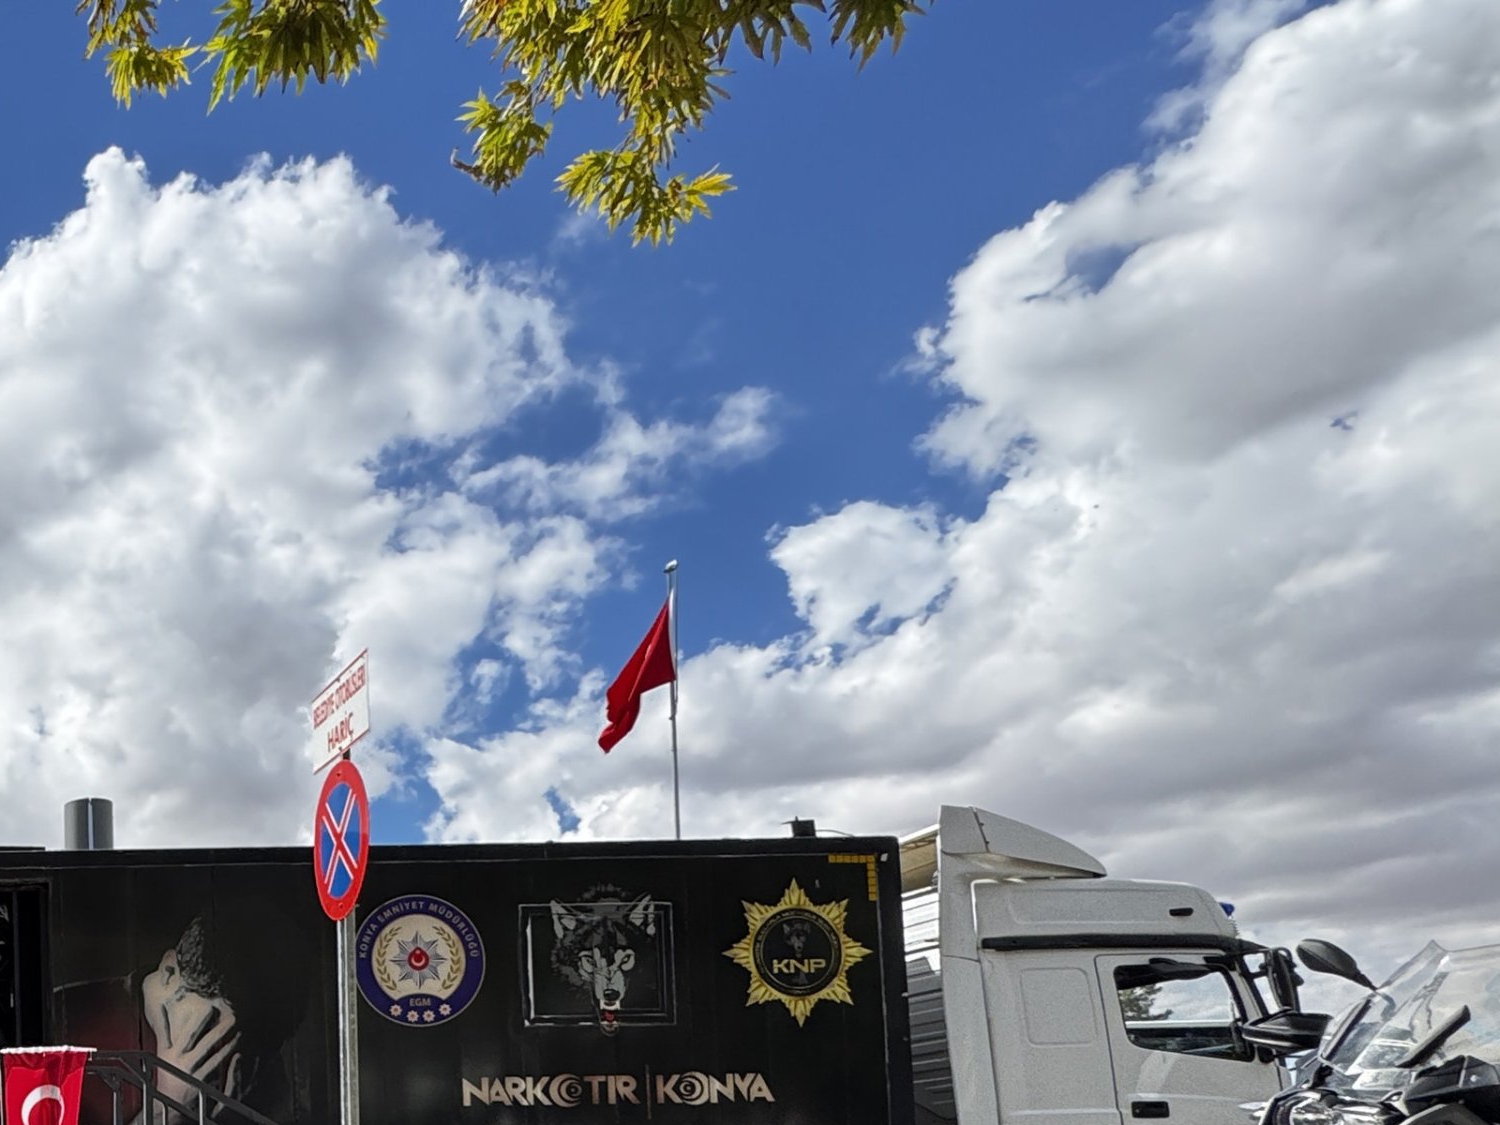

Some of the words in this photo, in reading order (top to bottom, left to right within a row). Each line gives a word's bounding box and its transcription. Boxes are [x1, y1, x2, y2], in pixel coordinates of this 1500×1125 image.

[359, 922, 379, 958] KONYA
[376, 901, 424, 922] EMNİYET
[428, 903, 480, 957] MÜDÜRLÜĞÜ
[772, 958, 827, 974] KNP
[409, 998, 431, 1007] EGM
[656, 1071, 776, 1106] KONYA
